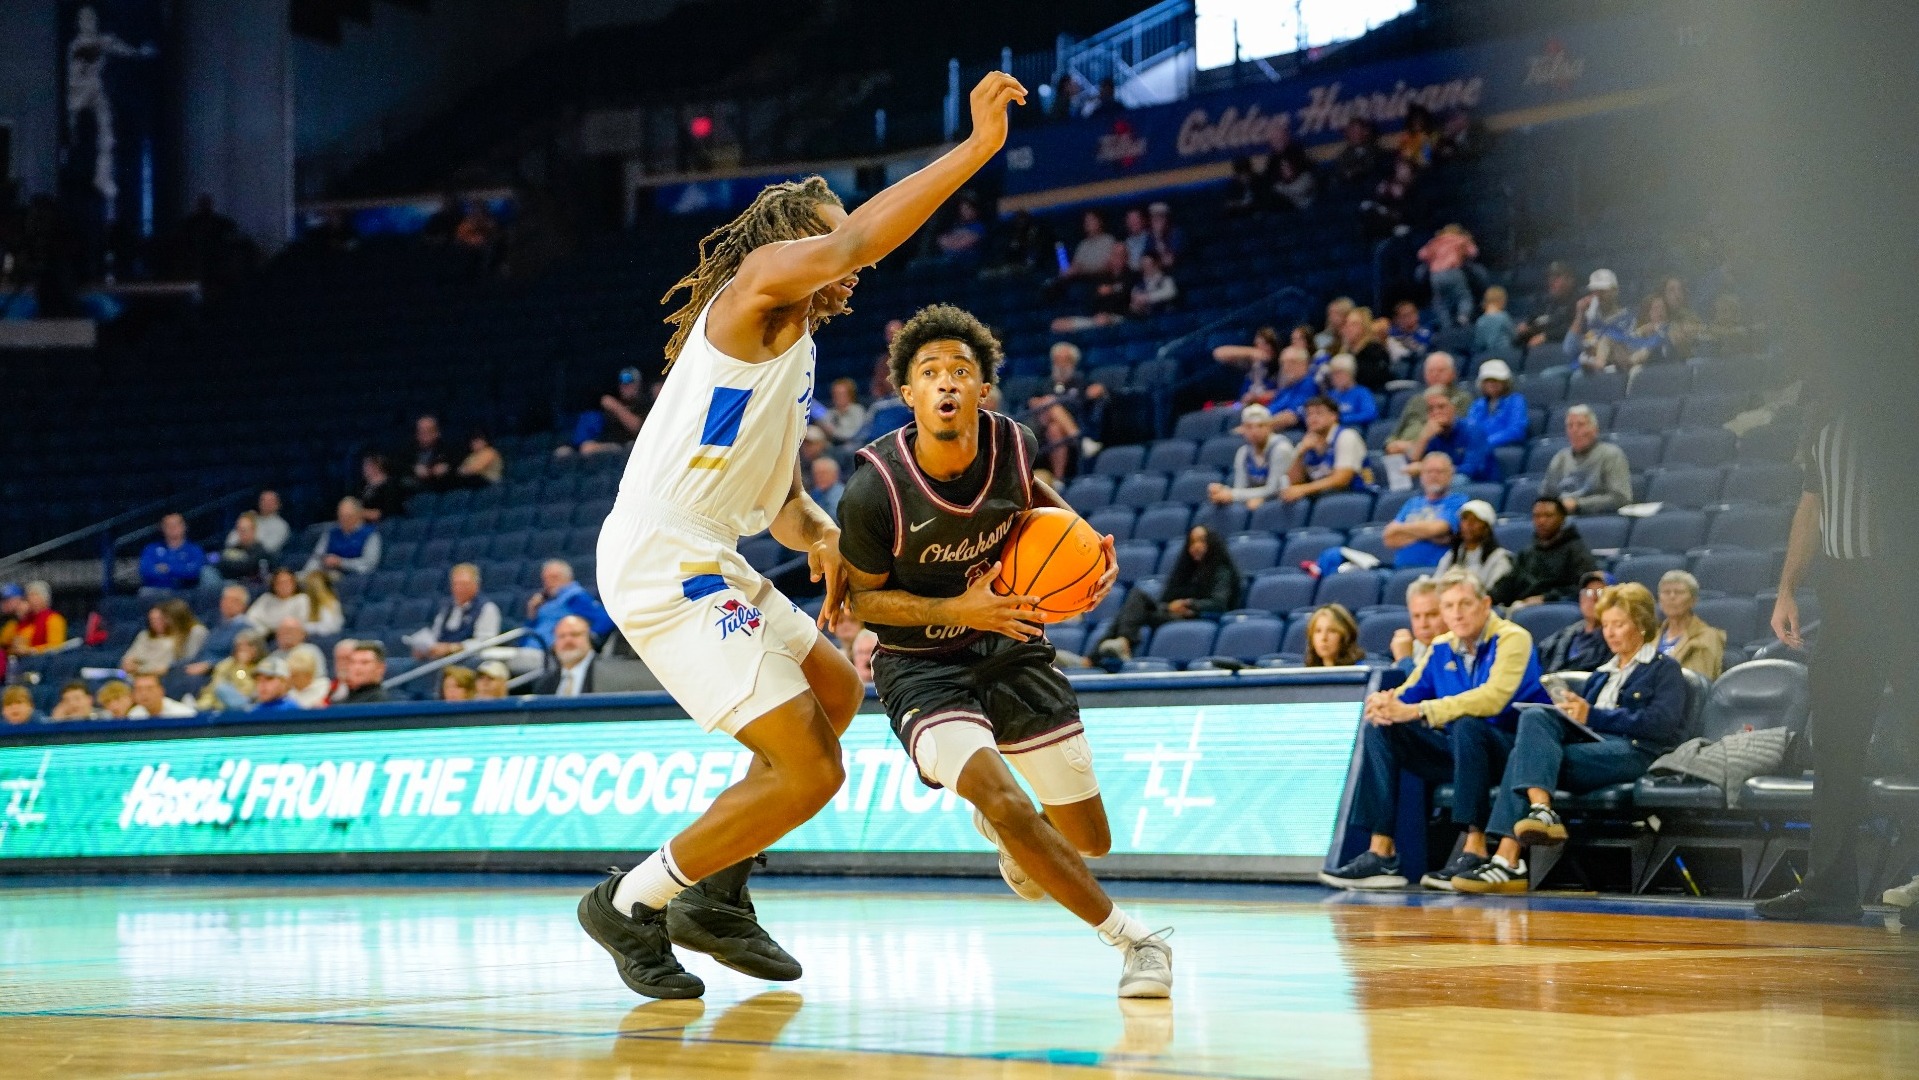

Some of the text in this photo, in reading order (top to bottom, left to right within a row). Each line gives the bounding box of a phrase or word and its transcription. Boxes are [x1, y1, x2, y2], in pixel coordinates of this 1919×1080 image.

[1176, 76, 1482, 157] Golden Hurricane
[715, 606, 762, 640] Tulsa
[239, 760, 375, 820] FROM
[379, 757, 474, 817] THE
